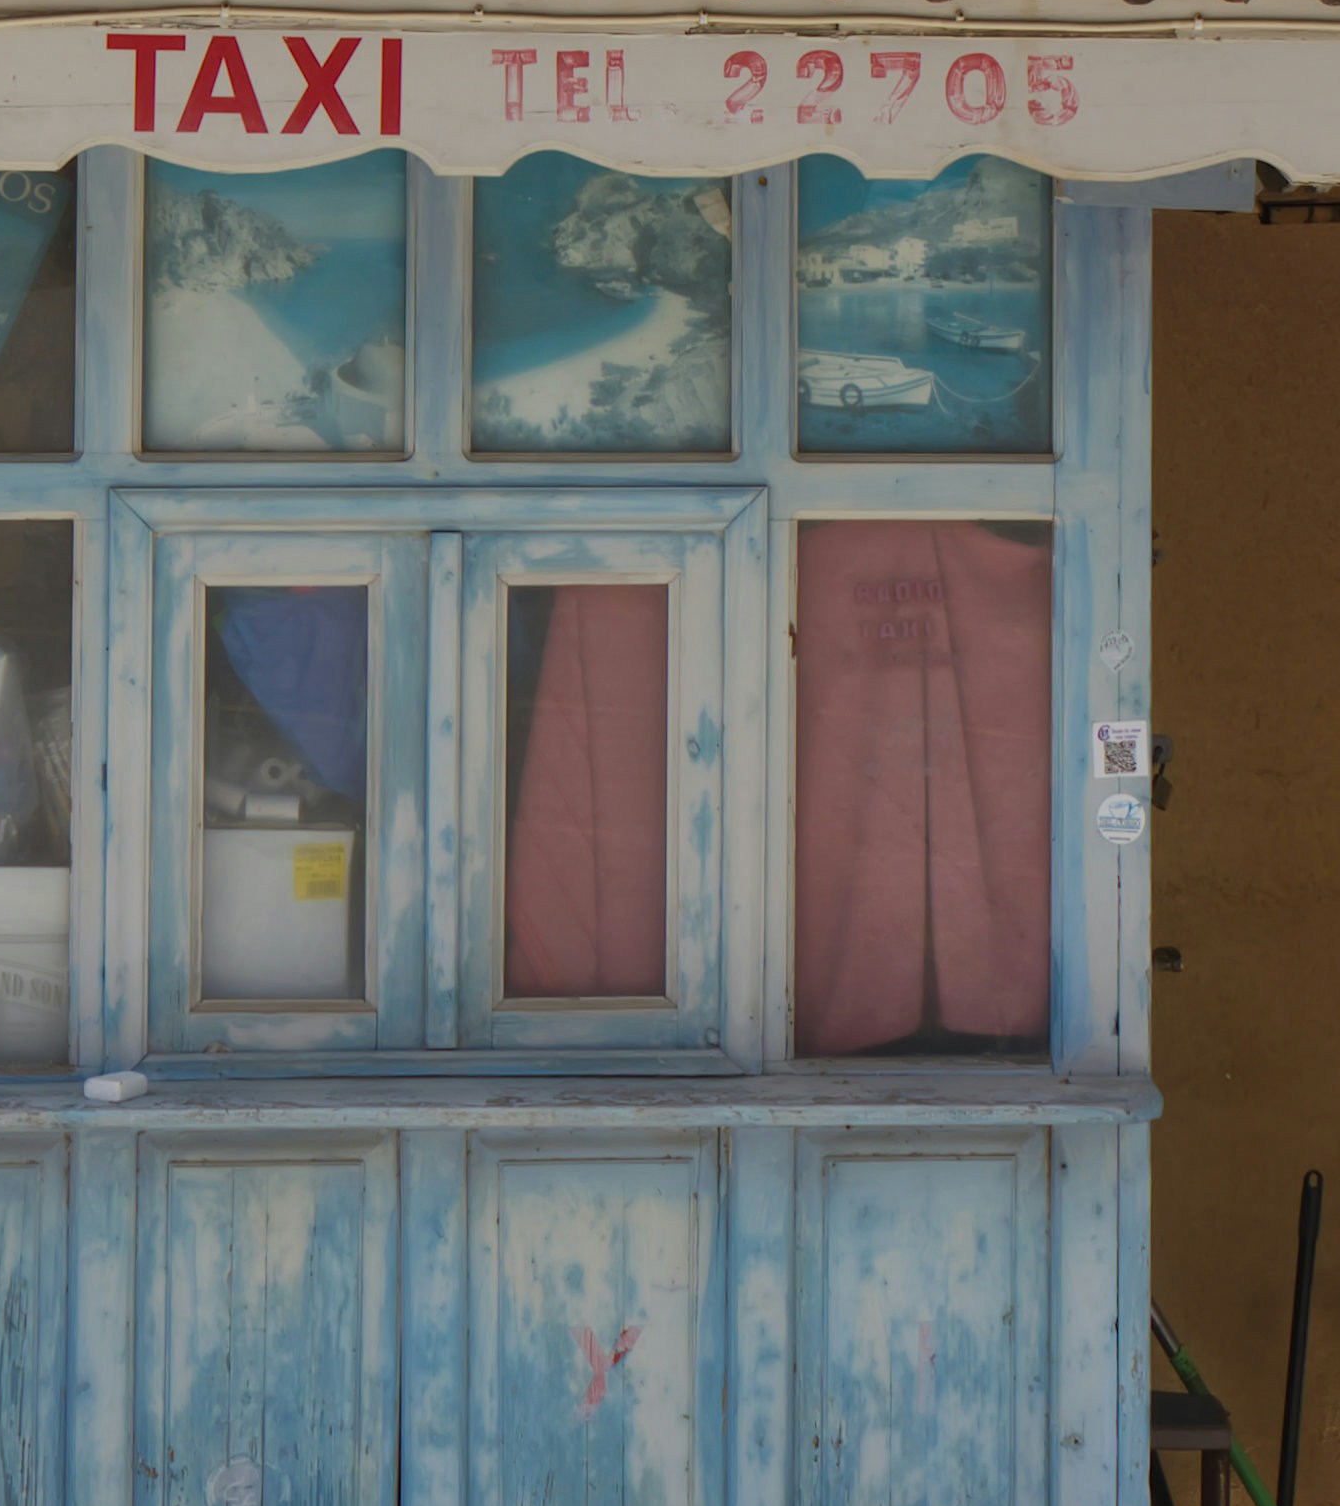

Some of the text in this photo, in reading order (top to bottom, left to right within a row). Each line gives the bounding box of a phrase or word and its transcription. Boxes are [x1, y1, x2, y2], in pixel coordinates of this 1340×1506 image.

[106, 33, 1080, 135] TAXI TEL 22705
